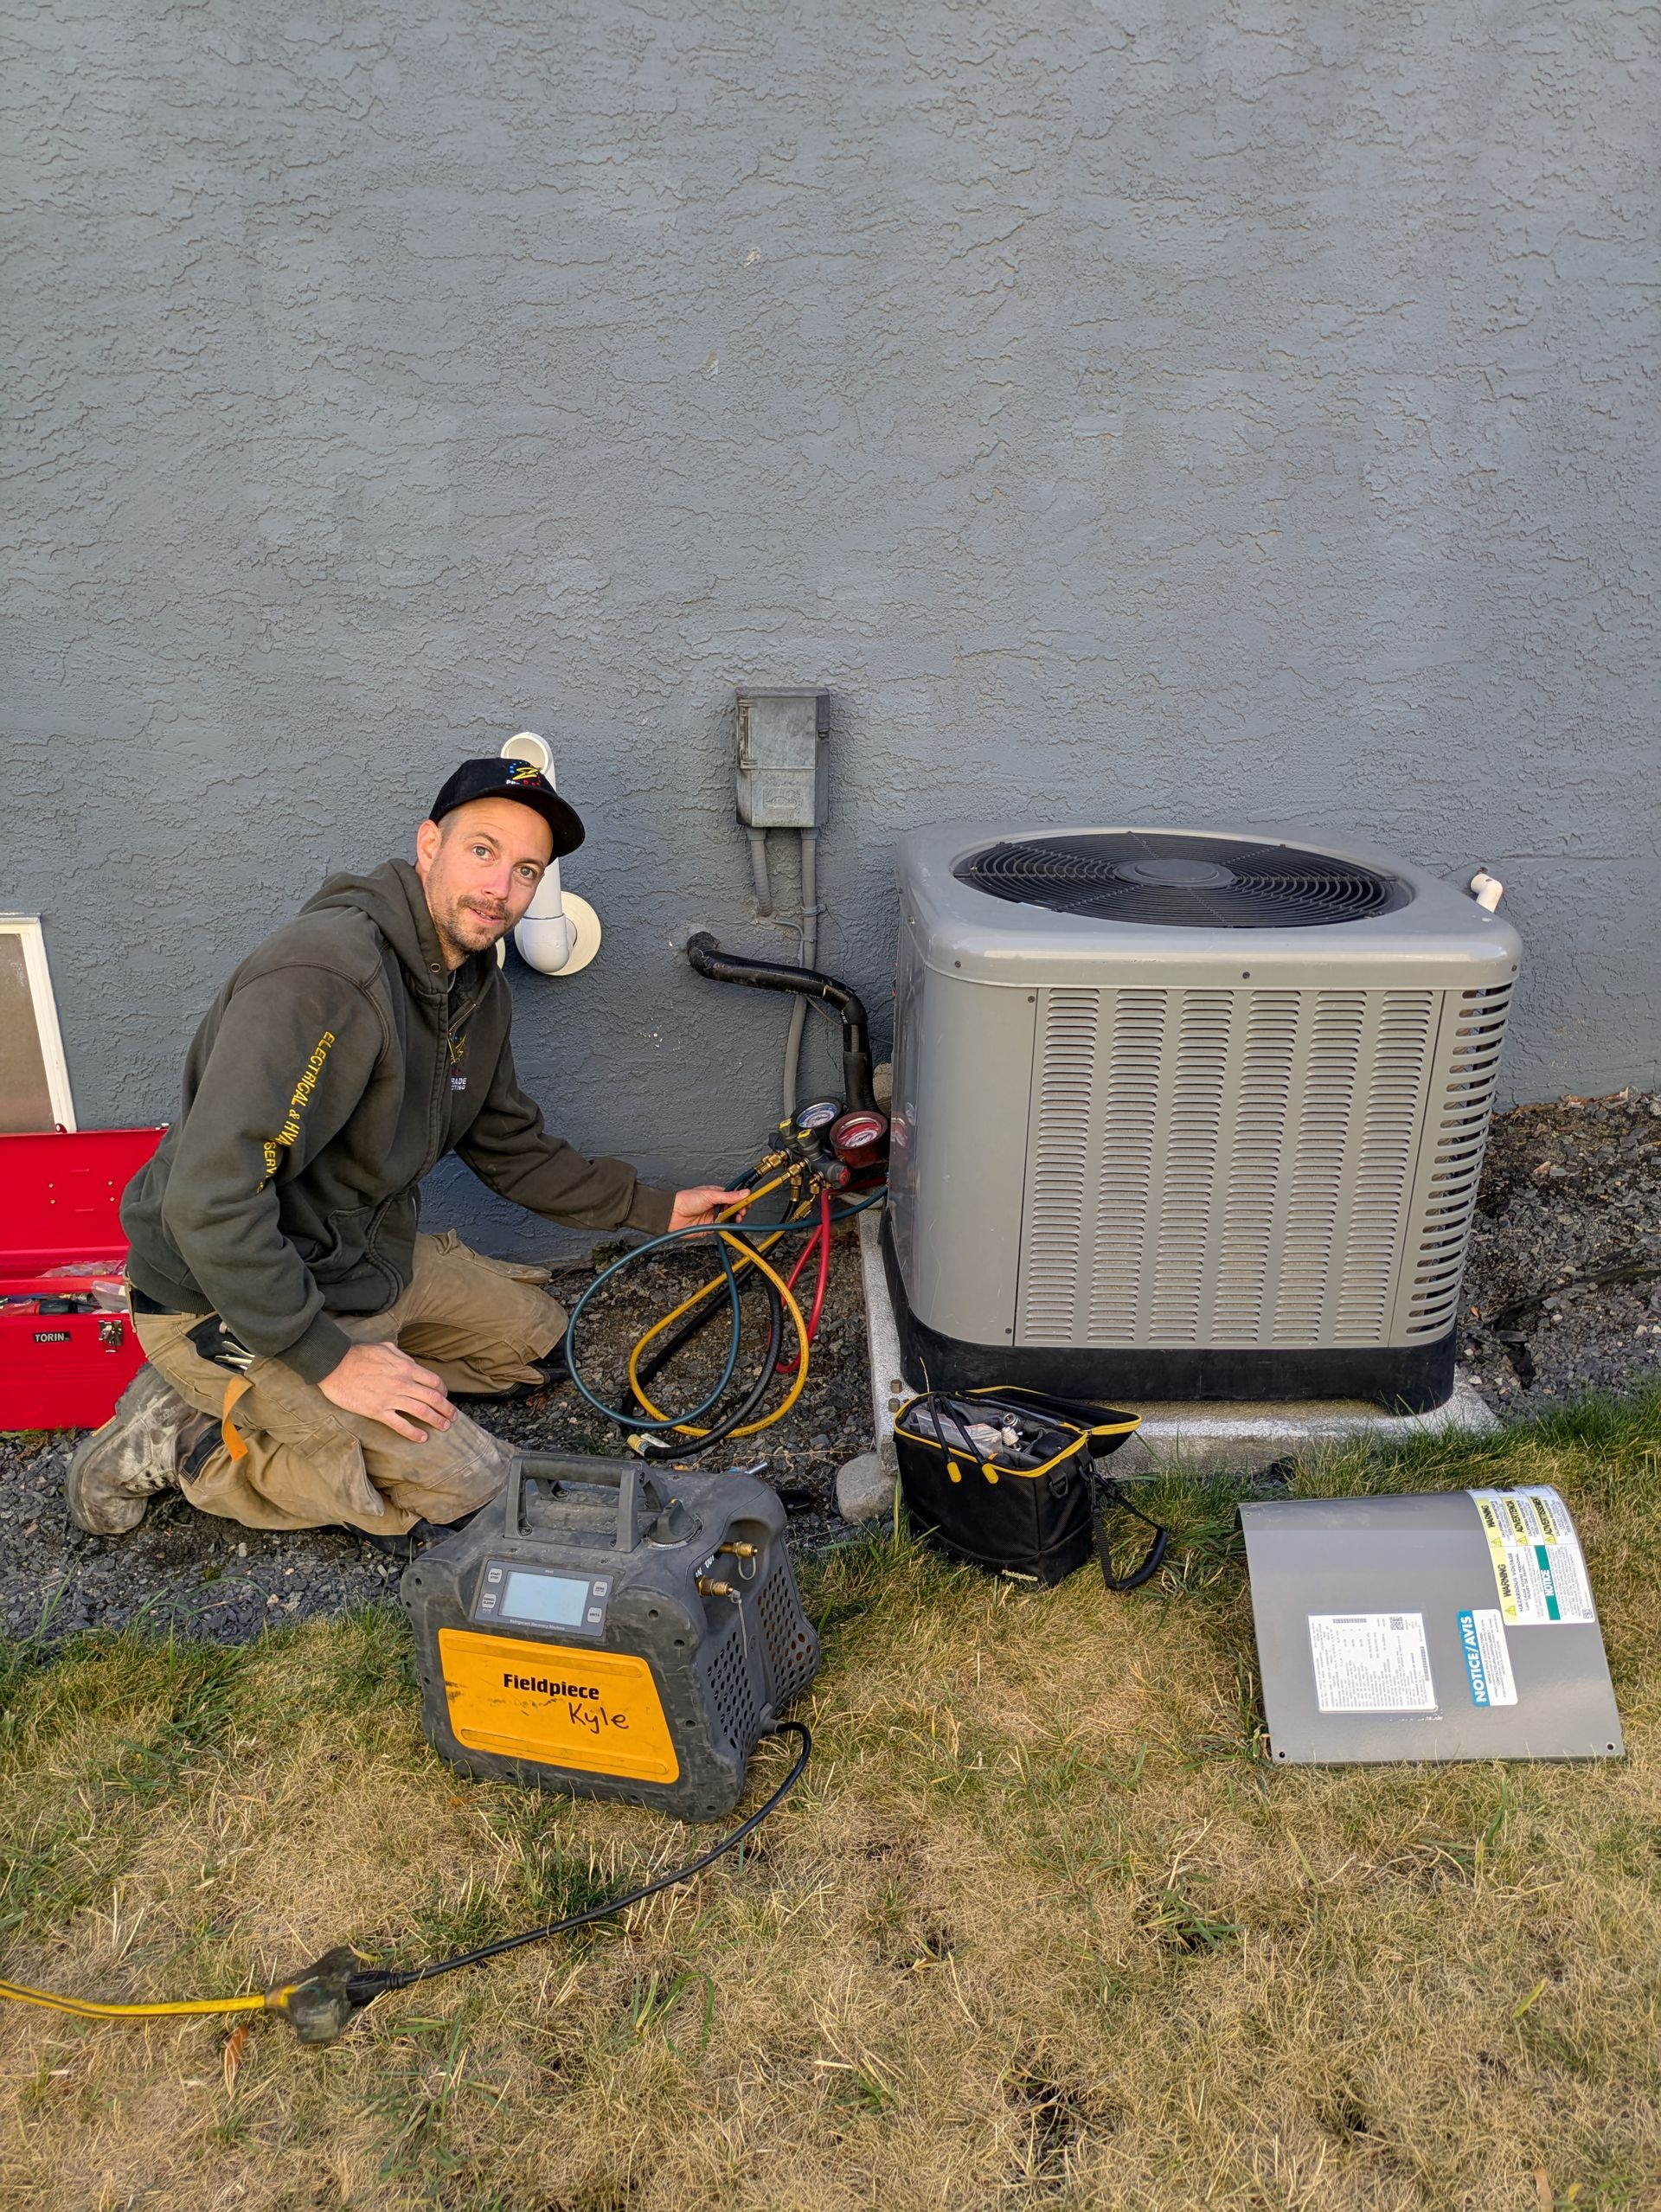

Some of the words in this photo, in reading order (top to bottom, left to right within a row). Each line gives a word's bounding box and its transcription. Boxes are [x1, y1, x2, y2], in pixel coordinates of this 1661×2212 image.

[291, 1031, 336, 1106] ELECTRICAL
[289, 1109, 301, 1119] &
[273, 1120, 300, 1146] HVA
[35, 1333, 65, 1343] TORIN
[1481, 1505, 1496, 1529] WARNING
[1507, 1553, 1517, 1575] VOLTAGE
[1497, 1564, 1511, 1598] WARNING
[1513, 1577, 1523, 1612] HAZARDOUS
[1541, 1569, 1555, 1596] NOTICE
[1460, 1616, 1486, 1702] NOTICE/AVIS
[503, 1673, 600, 1700] Fieldpiece
[568, 1702, 629, 1734] Kyle
